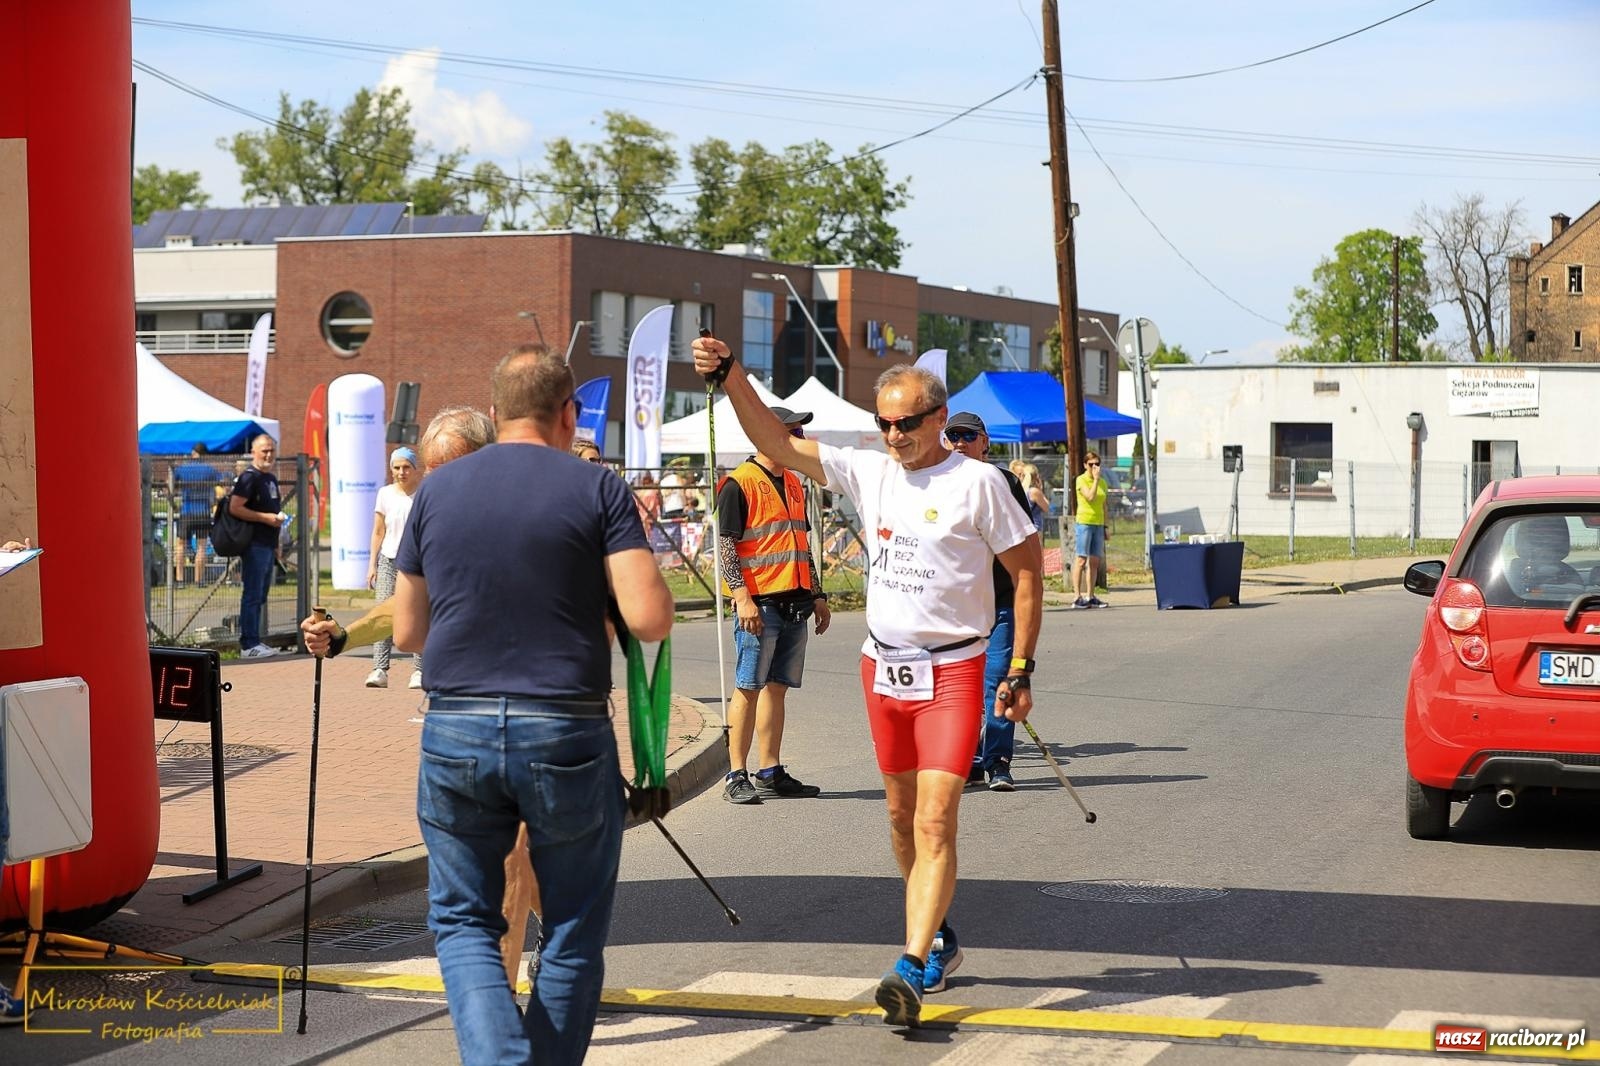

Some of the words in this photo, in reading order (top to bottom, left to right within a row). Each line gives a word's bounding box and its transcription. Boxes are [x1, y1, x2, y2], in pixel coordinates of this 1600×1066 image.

[1452, 380, 1480, 389] Sekcja
[1482, 381, 1535, 389] Podnoszenia
[895, 536, 918, 548] BIEG
[895, 551, 914, 561] BEZ
[901, 584, 924, 594] 2019
[1553, 656, 1594, 678] SWD
[159, 667, 192, 706] 12
